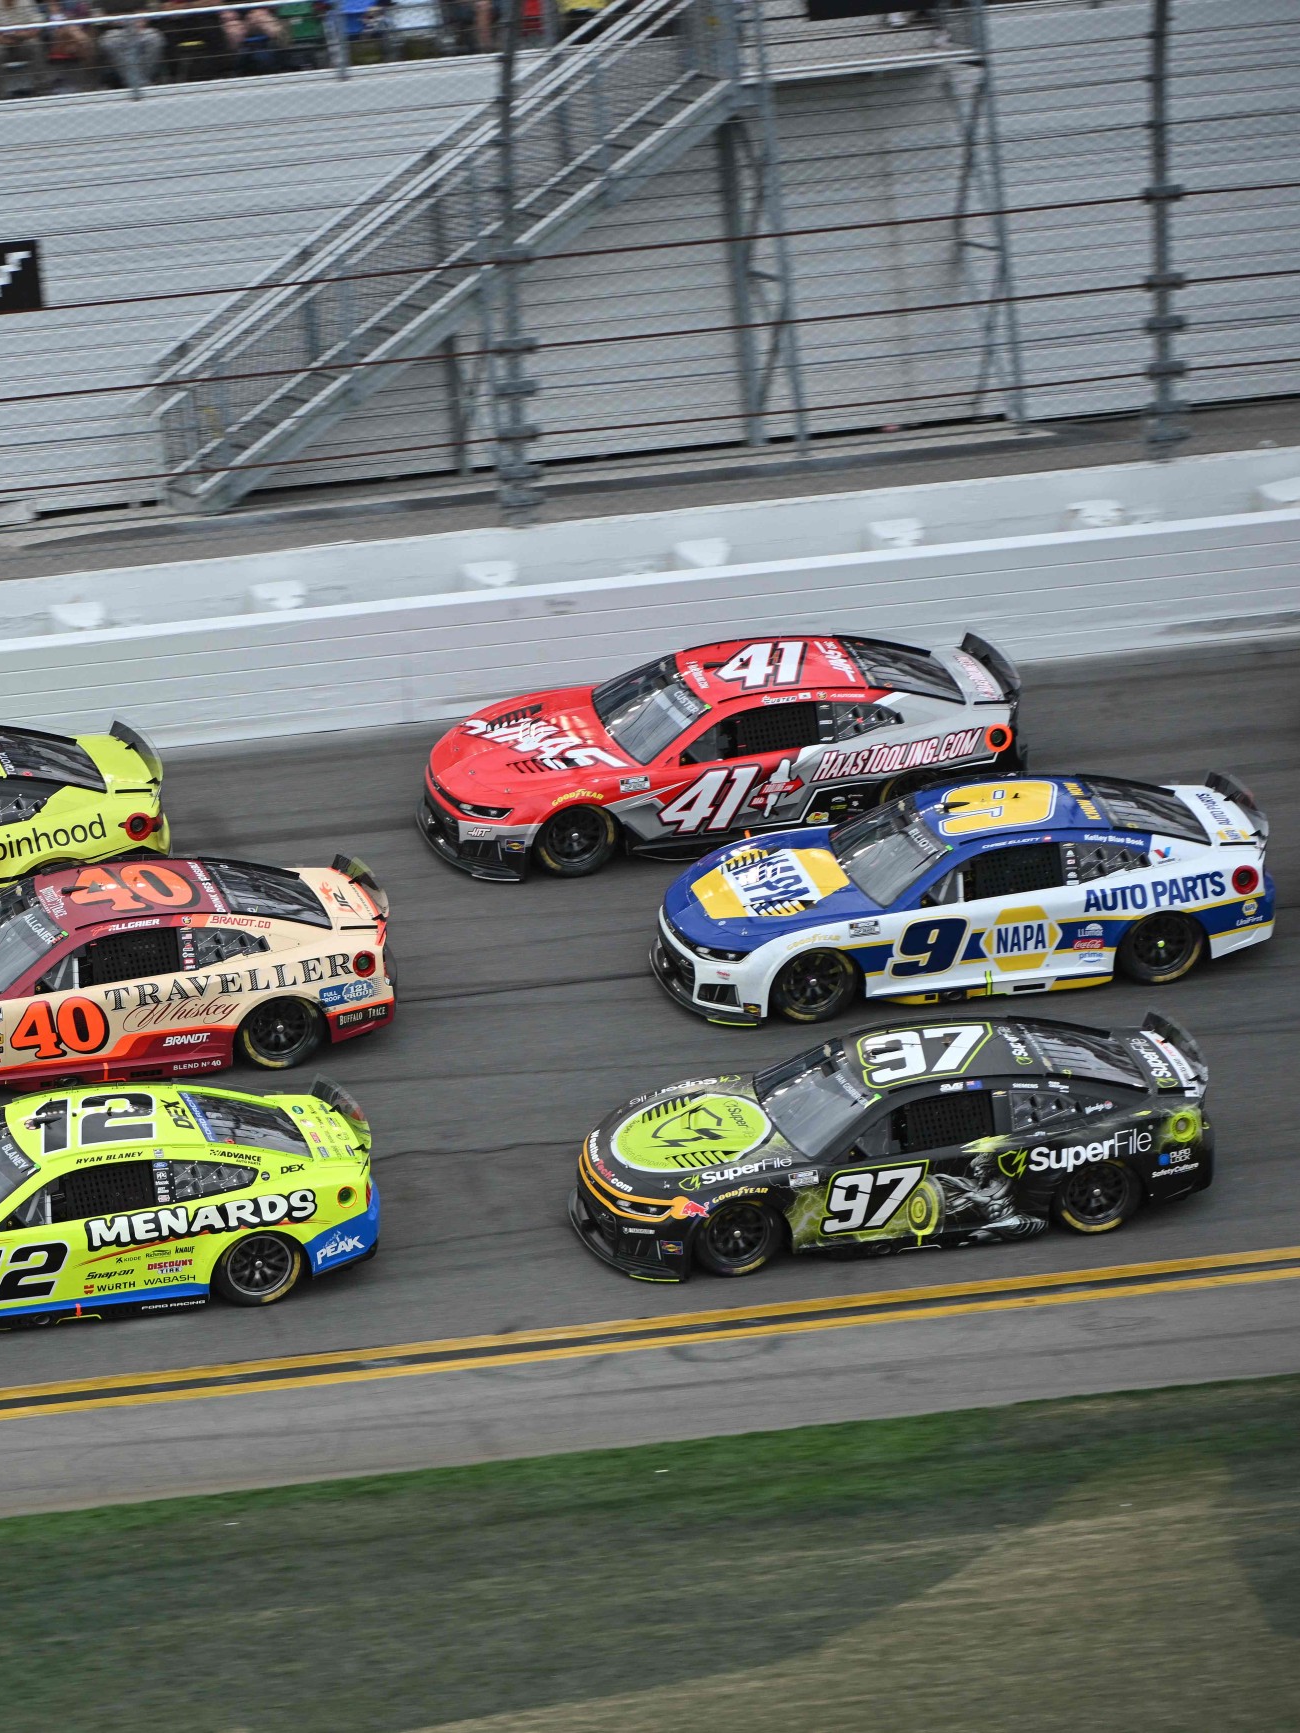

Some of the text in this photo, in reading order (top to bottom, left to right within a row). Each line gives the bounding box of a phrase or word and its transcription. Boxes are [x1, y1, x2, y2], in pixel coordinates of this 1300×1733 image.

[715, 640, 806, 689] 41
[674, 690, 698, 714] CUSTER
[551, 789, 604, 807] GOODYEAR
[658, 764, 761, 835] 41
[938, 780, 1058, 836] 9
[908, 828, 939, 856] ELLIOTT
[1084, 834, 1145, 846] Kelley Blue Book
[70, 864, 196, 912] 40
[1084, 871, 1226, 913] AUTO PARTS
[209, 894, 227, 913] DRINK
[23, 914, 54, 945] ALLGAIER
[108, 919, 160, 931] ALLGAIER
[210, 916, 271, 929] BRANDT.CO
[1235, 915, 1263, 926] UniFirst
[890, 915, 971, 979] 9
[996, 923, 1047, 954] NAPA
[104, 953, 354, 1011] TRAVELLER
[323, 990, 338, 998] FULL
[349, 983, 368, 993] 121
[123, 995, 241, 1032] Whiskey
[339, 1006, 386, 1026] BUFFALO TRACE
[10, 997, 110, 1060] 40
[163, 1033, 210, 1047] BRANDT
[173, 1063, 199, 1071] BLEND
[865, 1025, 984, 1083] 97
[1131, 1038, 1171, 1079] SuperFile
[35, 1093, 154, 1155] 12
[161, 1099, 194, 1129] DEX
[198, 1115, 215, 1141] FORD
[1, 1143, 29, 1170] BLANEY
[76, 1151, 143, 1165] RYAN BLANEY
[220, 1150, 262, 1162] ADVANCE
[588, 1129, 633, 1194] WeatherTech.com
[1029, 1129, 1152, 1172] SuperFile
[281, 1164, 305, 1174] DEX
[702, 1156, 793, 1185] SuperFile
[712, 1186, 769, 1204] GOODYEAR
[824, 1167, 923, 1233] 97
[87, 1190, 316, 1250] MENARDS
[316, 1235, 366, 1265] PEAK
[85, 1268, 134, 1281] Snap-on
[147, 1259, 193, 1270] DISCOUNT
[144, 1274, 196, 1286] WABASH
